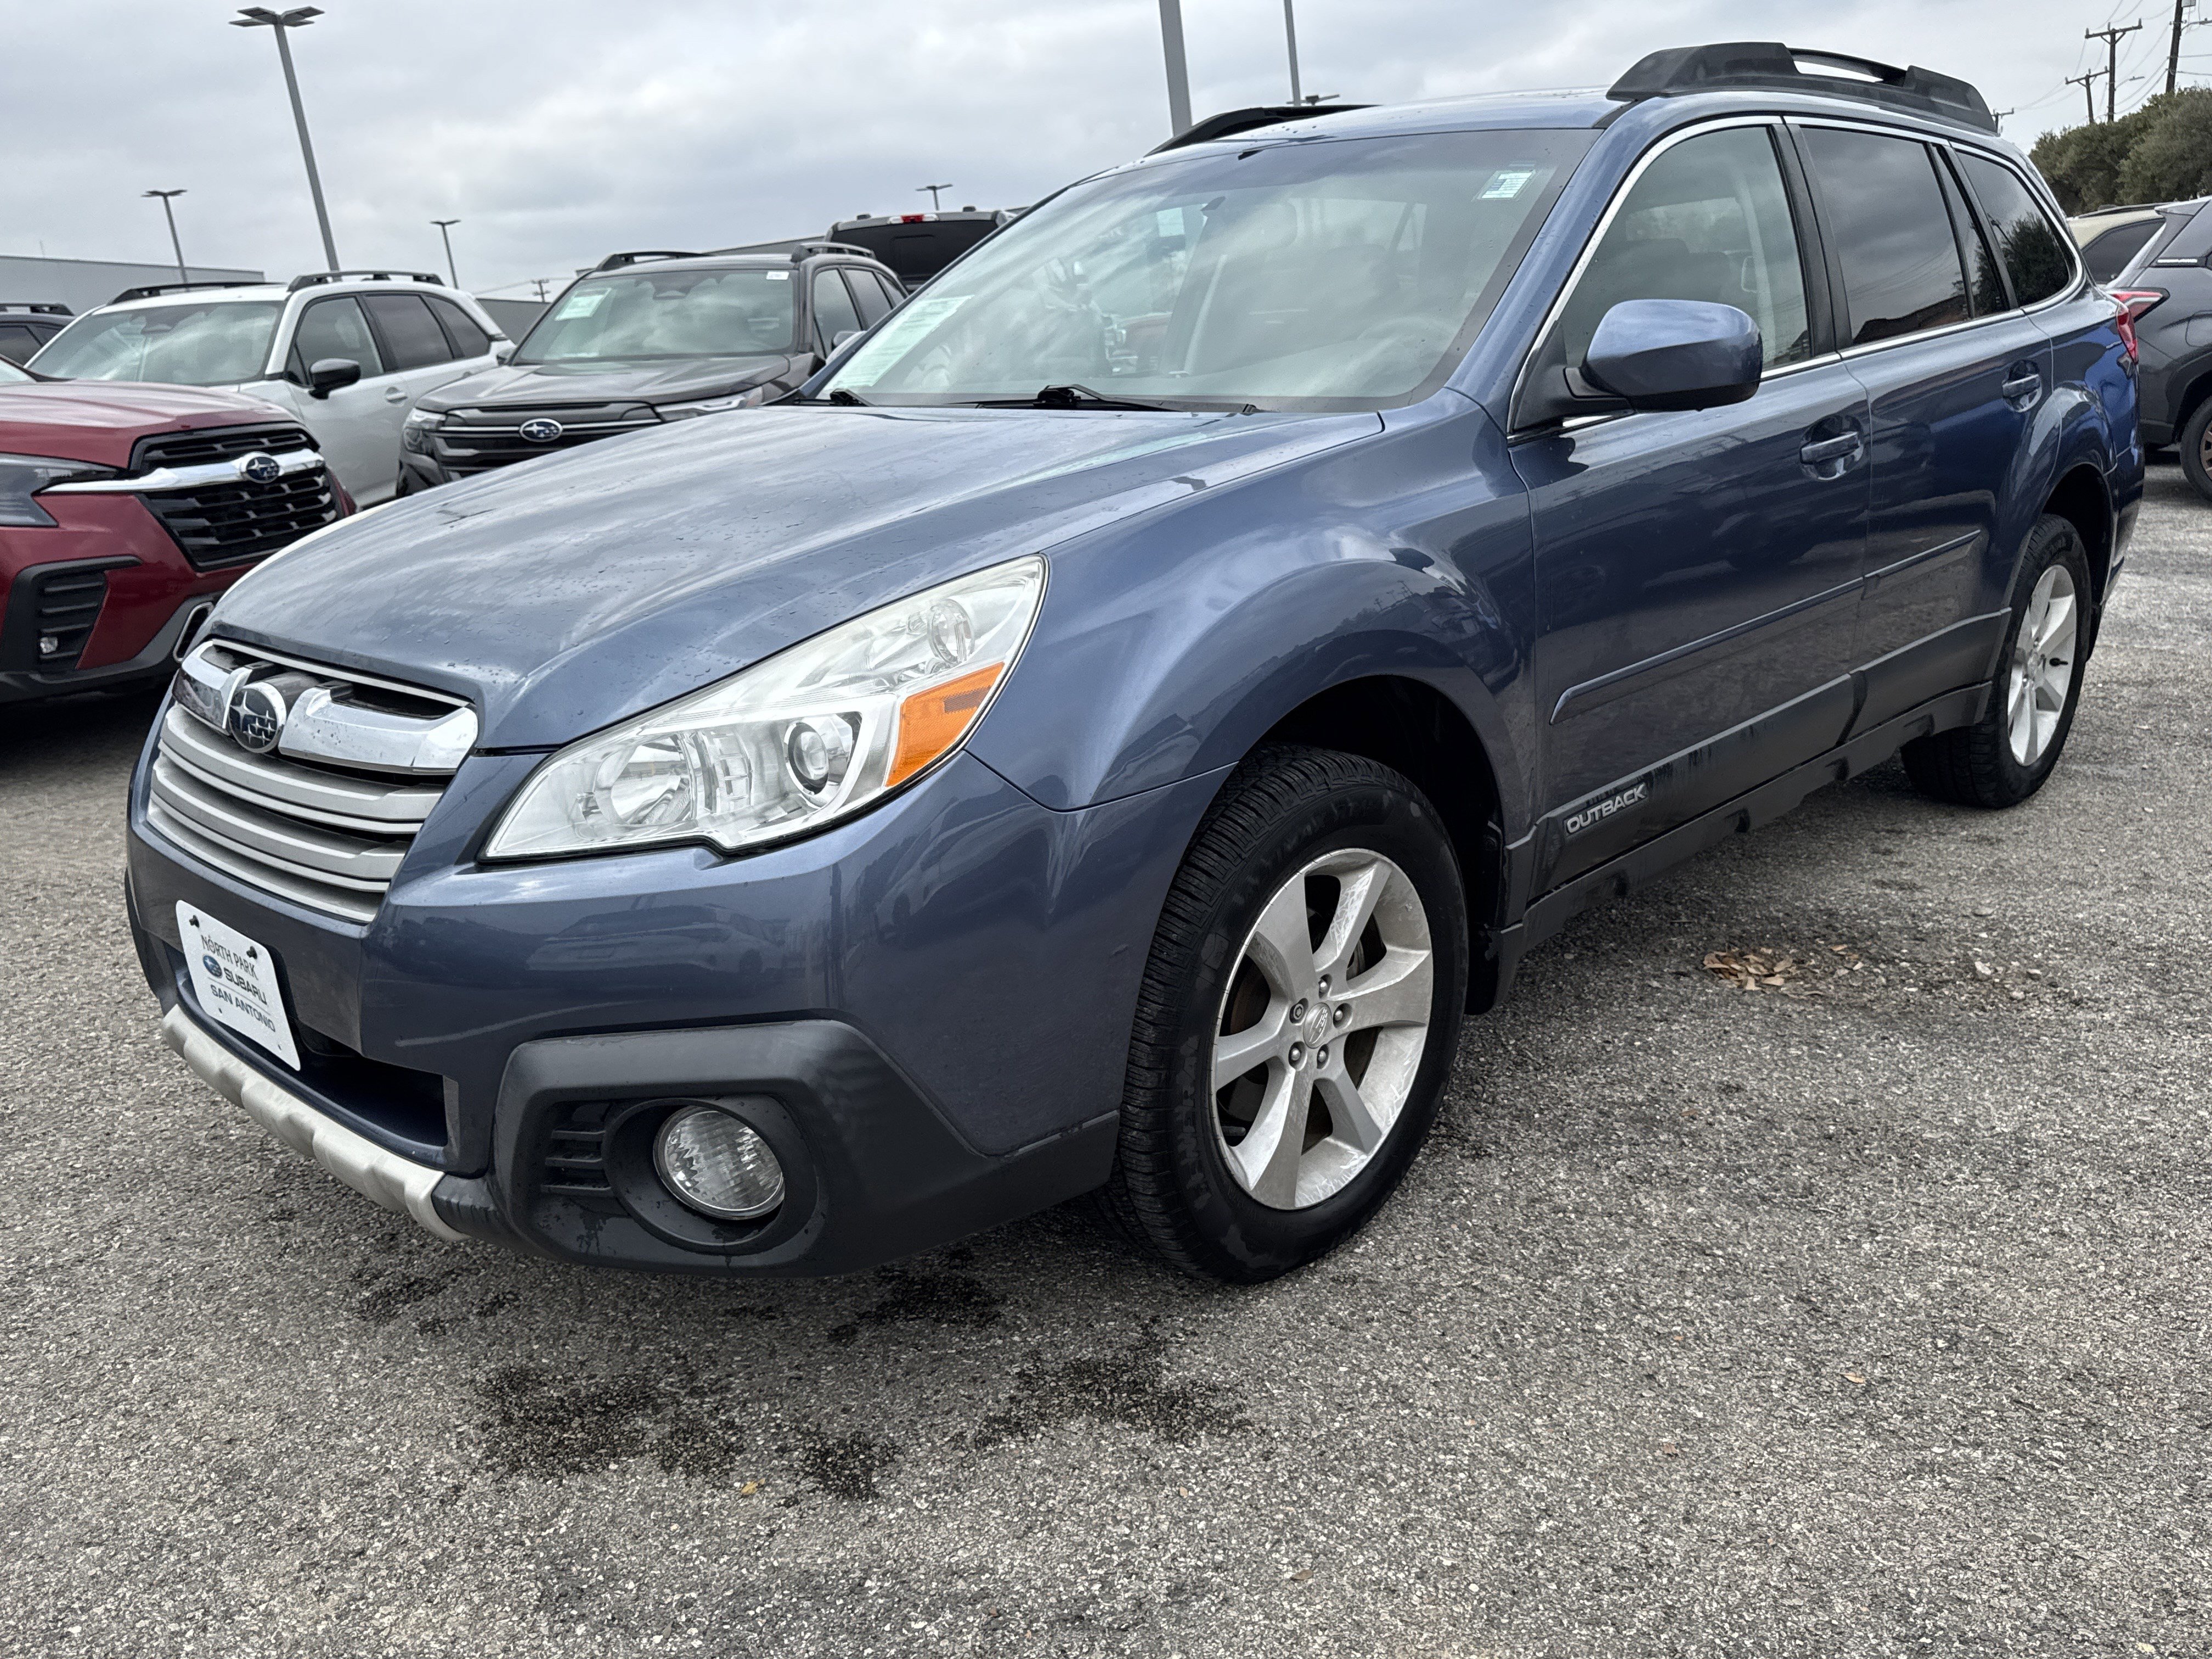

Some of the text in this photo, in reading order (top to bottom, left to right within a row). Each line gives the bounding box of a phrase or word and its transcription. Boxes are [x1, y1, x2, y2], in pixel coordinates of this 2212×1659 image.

[1567, 783, 1645, 833] OUTBACK
[201, 934, 258, 980] NORTH PARK
[211, 984, 275, 1032] SAN ANTONIO
[223, 967, 267, 1005] SUBARU
